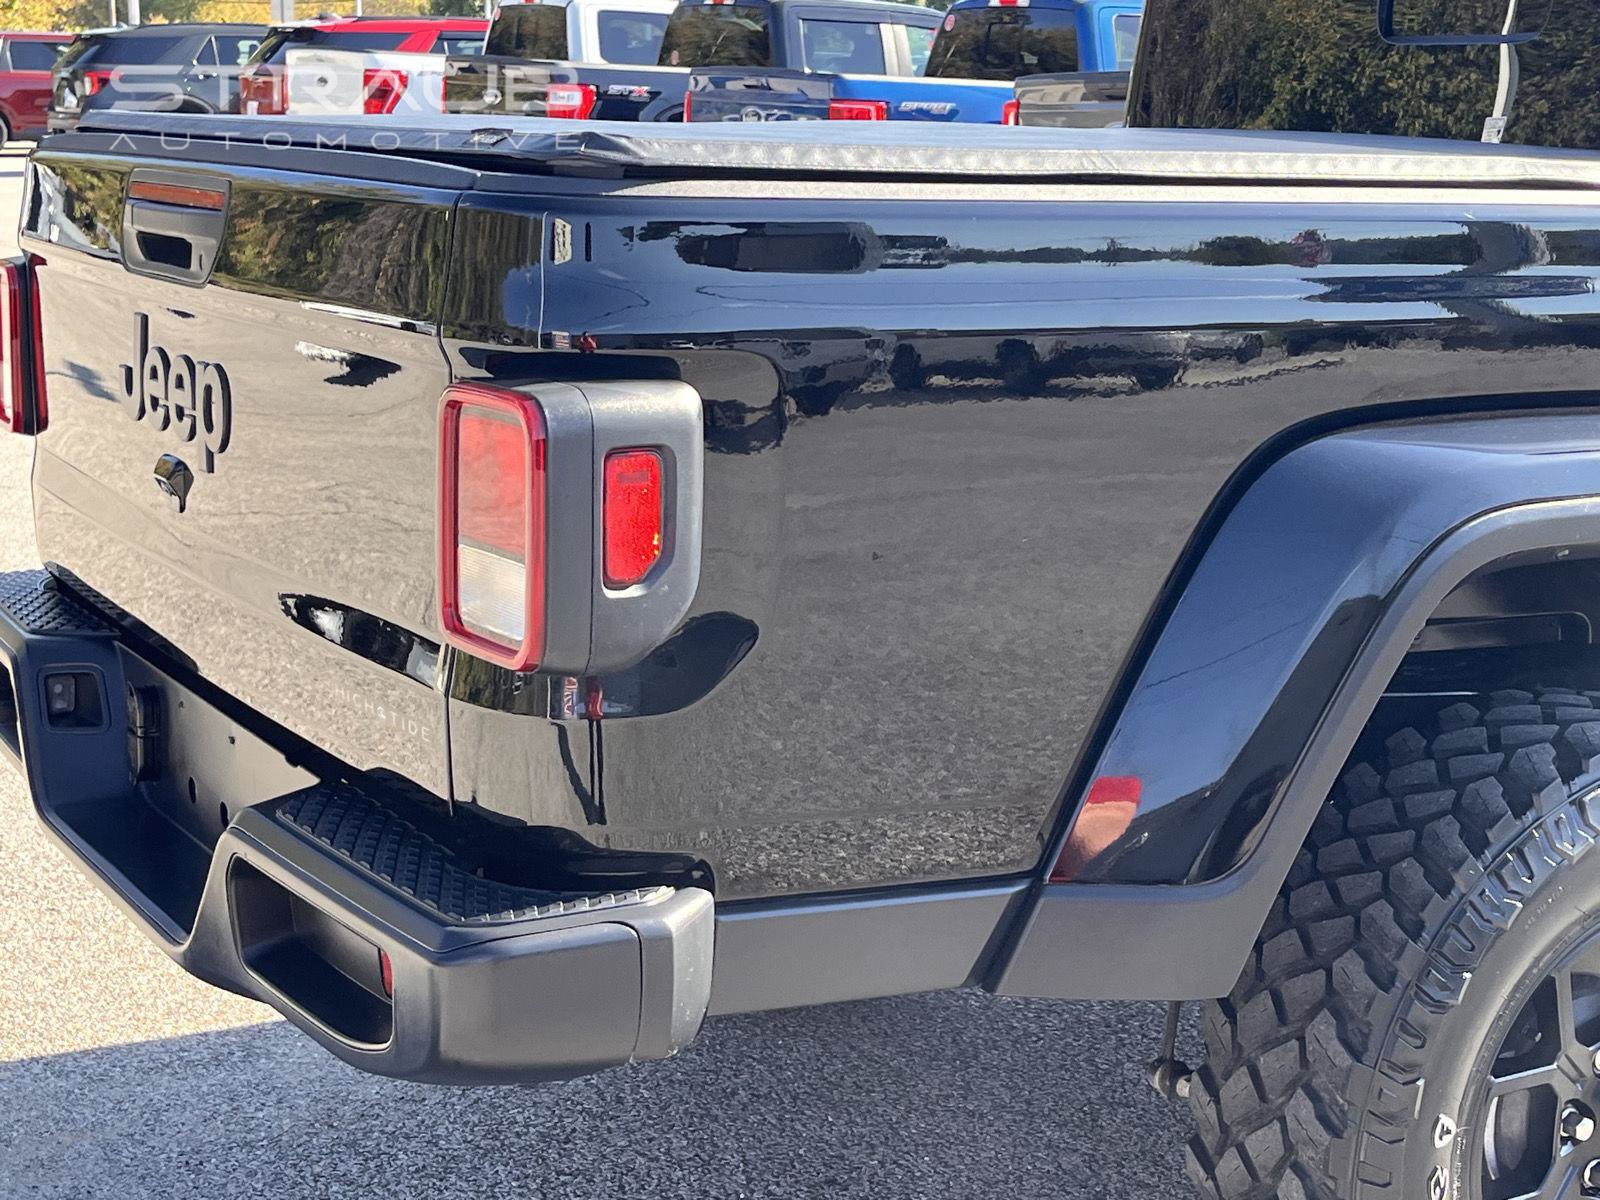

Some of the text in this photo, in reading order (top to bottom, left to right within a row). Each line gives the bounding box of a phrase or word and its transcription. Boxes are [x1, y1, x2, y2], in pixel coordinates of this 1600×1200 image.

[607, 84, 651, 101] STX
[899, 101, 956, 115] SPORT
[119, 312, 232, 473] Jeep
[390, 710, 432, 743] TIDE
